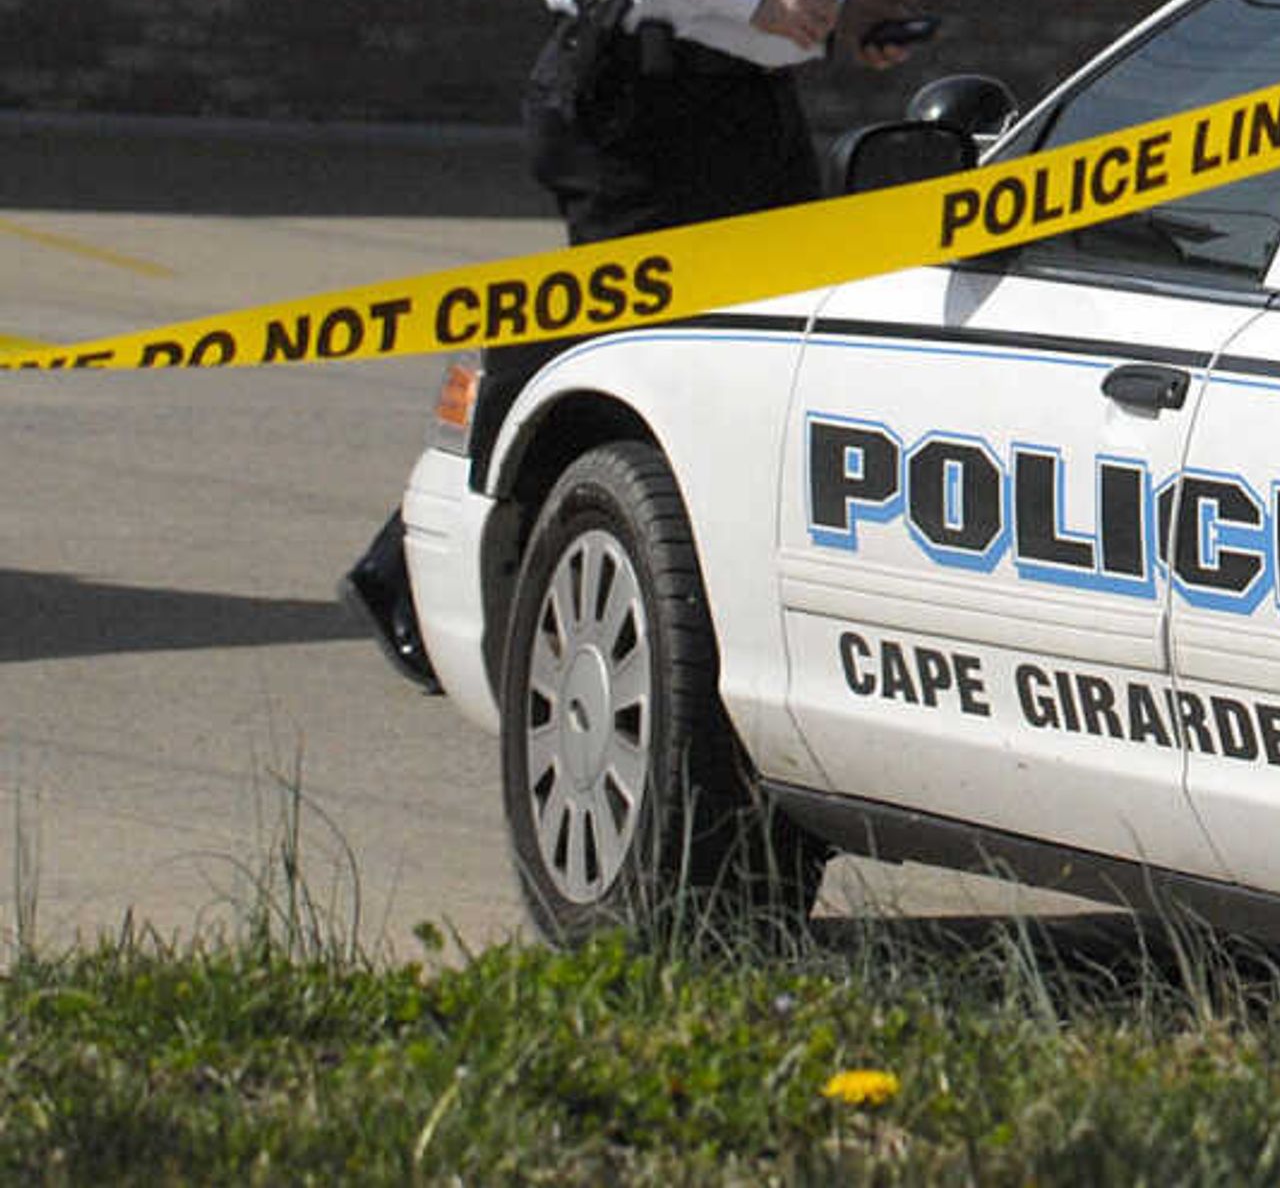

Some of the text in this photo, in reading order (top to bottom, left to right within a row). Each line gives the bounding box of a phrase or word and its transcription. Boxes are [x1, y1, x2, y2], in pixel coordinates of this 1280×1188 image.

[941, 134, 1171, 247] POLICE
[262, 298, 411, 362] NOT
[434, 256, 673, 345] CROSS
[839, 631, 991, 717] CAPE
